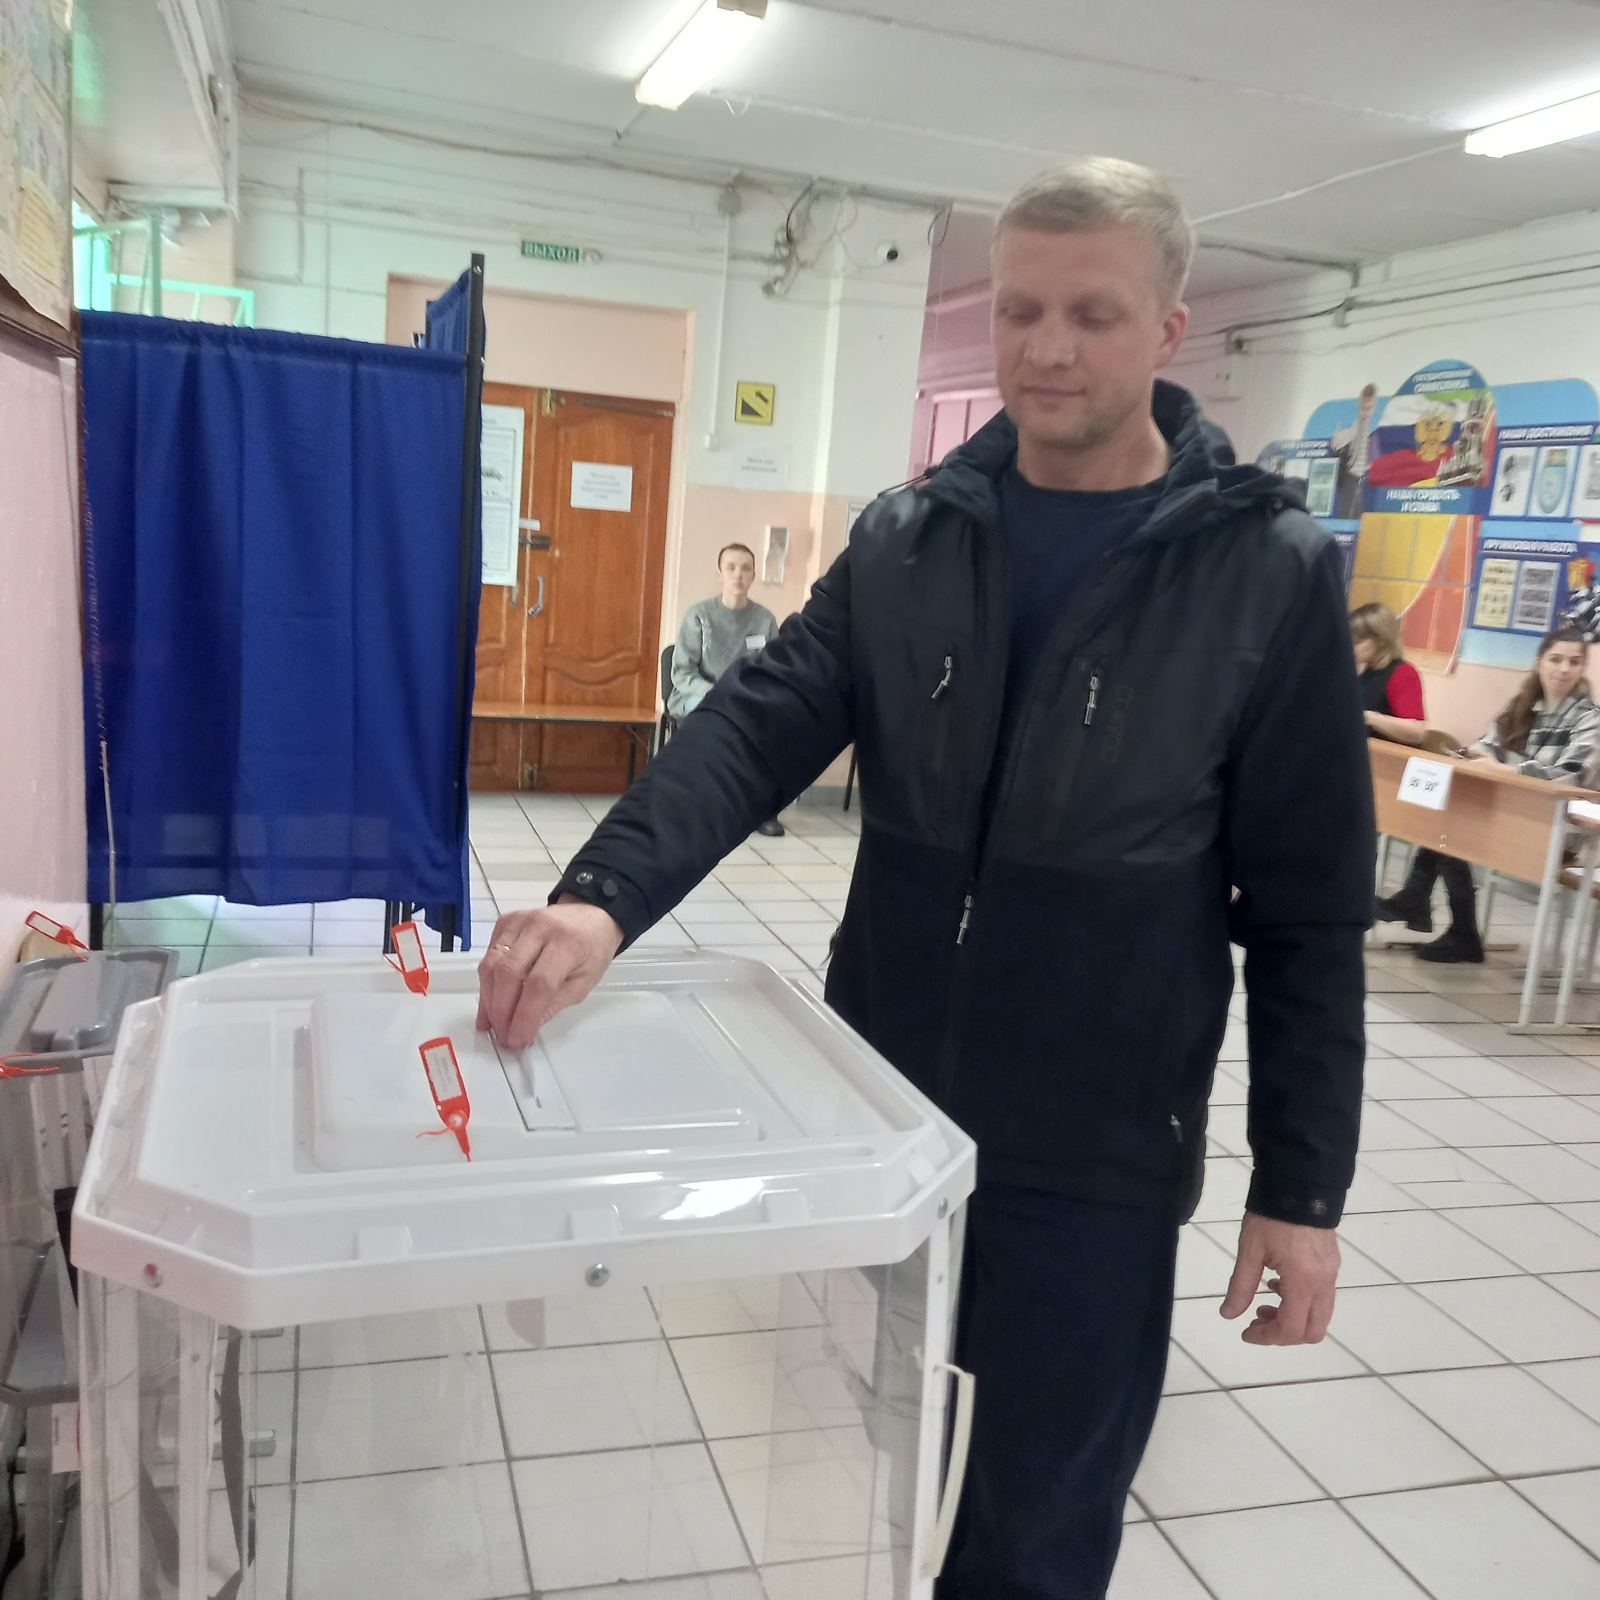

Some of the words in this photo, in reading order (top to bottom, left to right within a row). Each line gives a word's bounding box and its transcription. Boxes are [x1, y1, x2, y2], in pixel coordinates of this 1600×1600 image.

[525, 242, 578, 260] ВЫХОД
[1385, 489, 1413, 501] НАША
[1413, 488, 1461, 501] ГОРДОСТЬ
[1401, 502, 1409, 512] И
